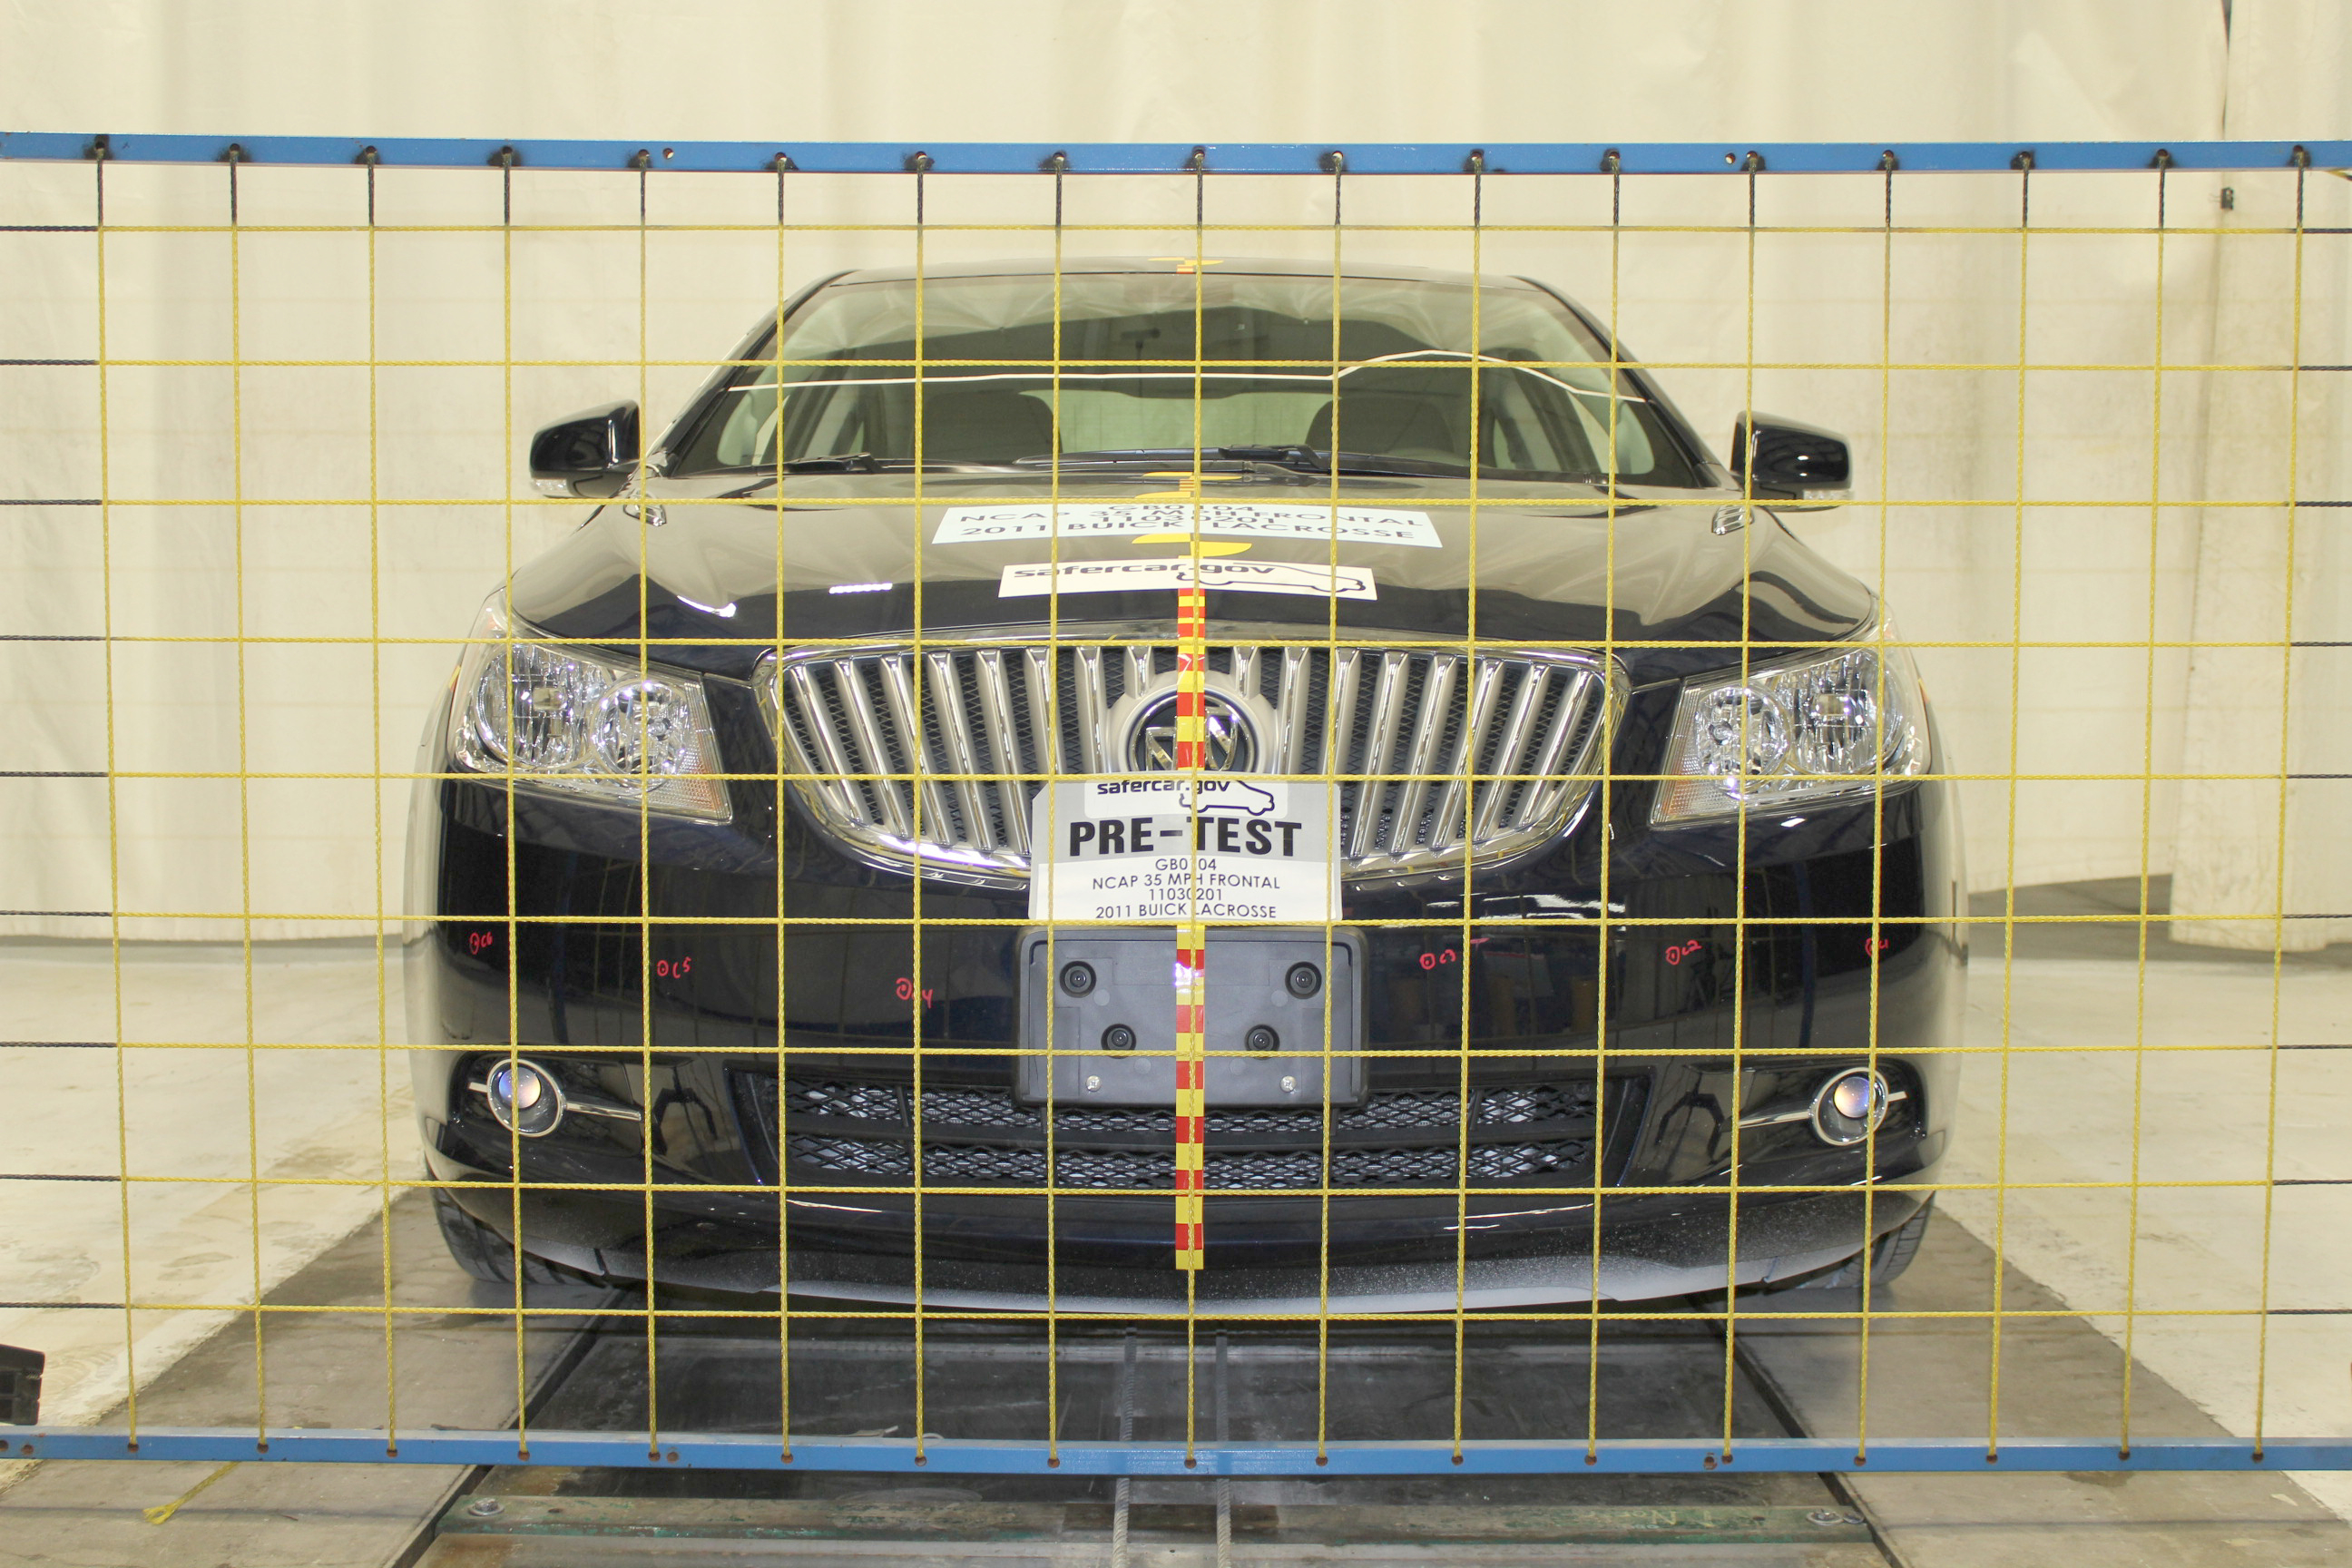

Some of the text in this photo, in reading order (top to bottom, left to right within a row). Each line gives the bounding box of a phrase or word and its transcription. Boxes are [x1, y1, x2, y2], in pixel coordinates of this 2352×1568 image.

[1255, 512, 1423, 526] FRONTAL
[960, 521, 1415, 538] 2011 BUICK LACROSSE
[1097, 779, 1230, 795] safercar.gov
[1070, 817, 1302, 857] PRE-TEST
[1155, 858, 1217, 870] GB004
[1093, 876, 1139, 889] NCAP
[1143, 874, 1162, 886] 35
[1210, 875, 1280, 889] FRONTAL
[1096, 906, 1131, 918] 2011
[1139, 904, 1187, 916] BUICK
